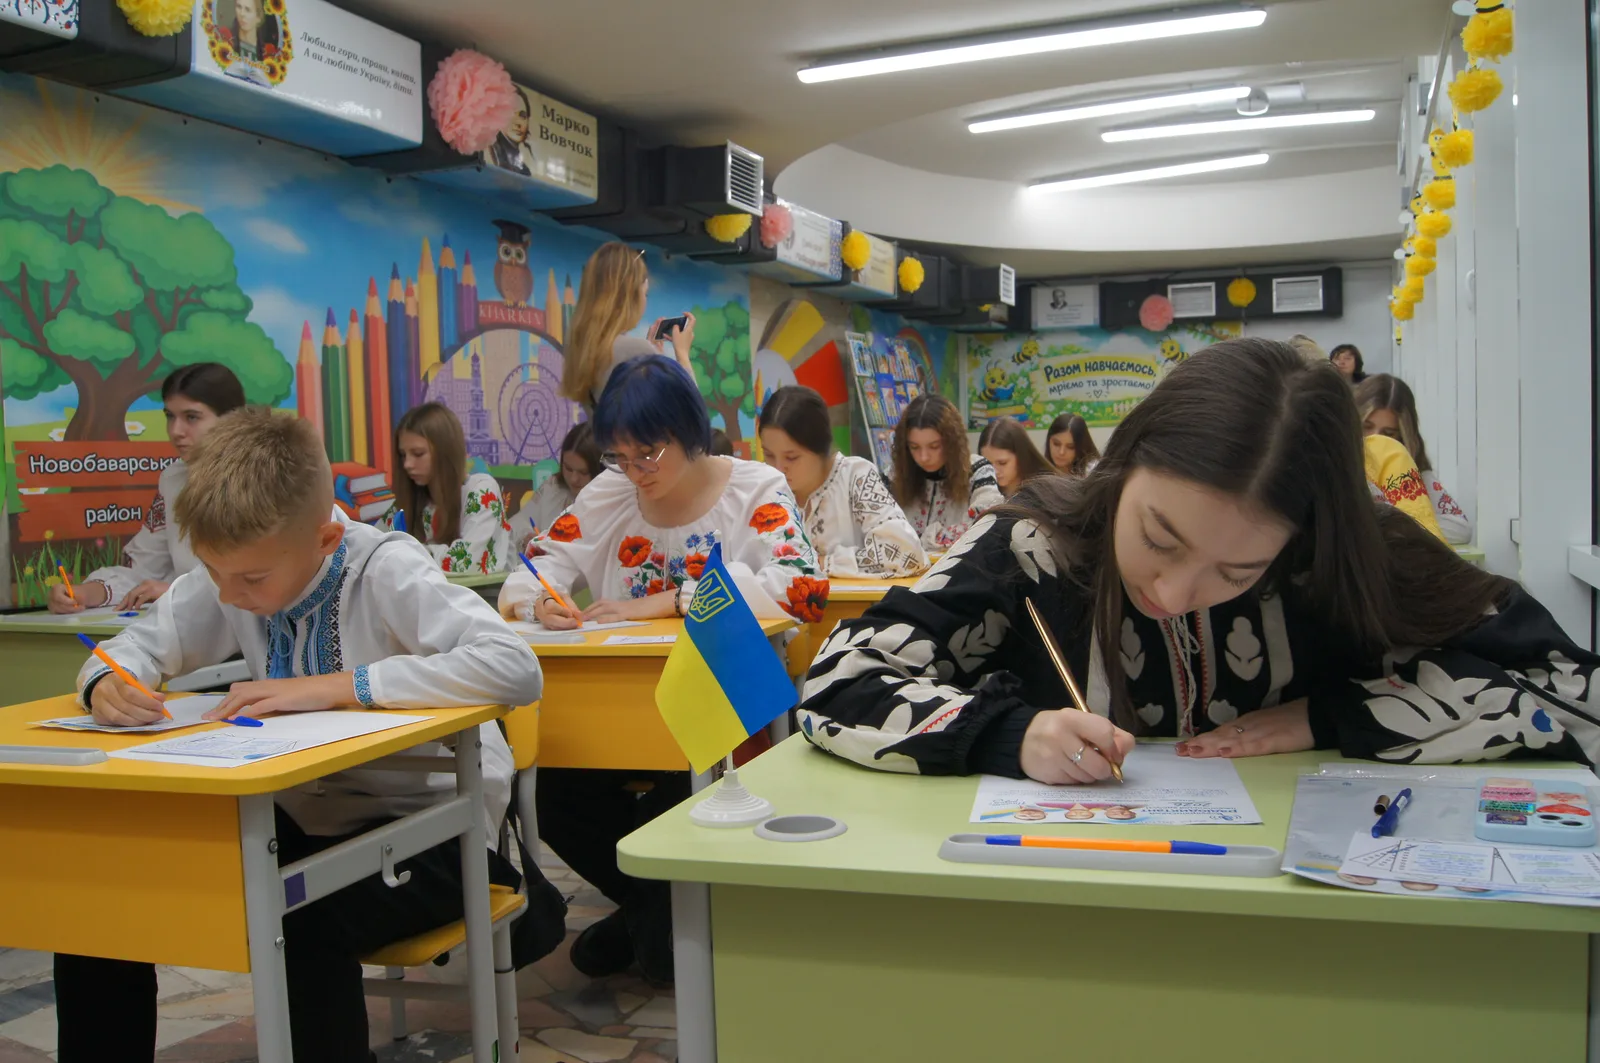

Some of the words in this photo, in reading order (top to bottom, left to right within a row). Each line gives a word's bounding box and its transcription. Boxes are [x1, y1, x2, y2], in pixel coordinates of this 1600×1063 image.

[300, 31, 336, 53] Любила
[338, 47, 360, 63] гори,
[361, 56, 390, 74] трави,
[304, 48, 310, 58] А
[312, 52, 323, 62] ви
[324, 57, 358, 74] любіте
[360, 67, 392, 89] Україну,
[393, 81, 414, 96] діти.
[542, 104, 590, 136] Марко
[539, 124, 593, 158] Вовчок
[1044, 363, 1082, 382] Разом
[1084, 360, 1157, 377] навчаємось,
[1048, 381, 1084, 395] мріємо
[1086, 379, 1098, 387] та
[1101, 379, 1155, 390] зростаємо!
[85, 504, 143, 528] район
